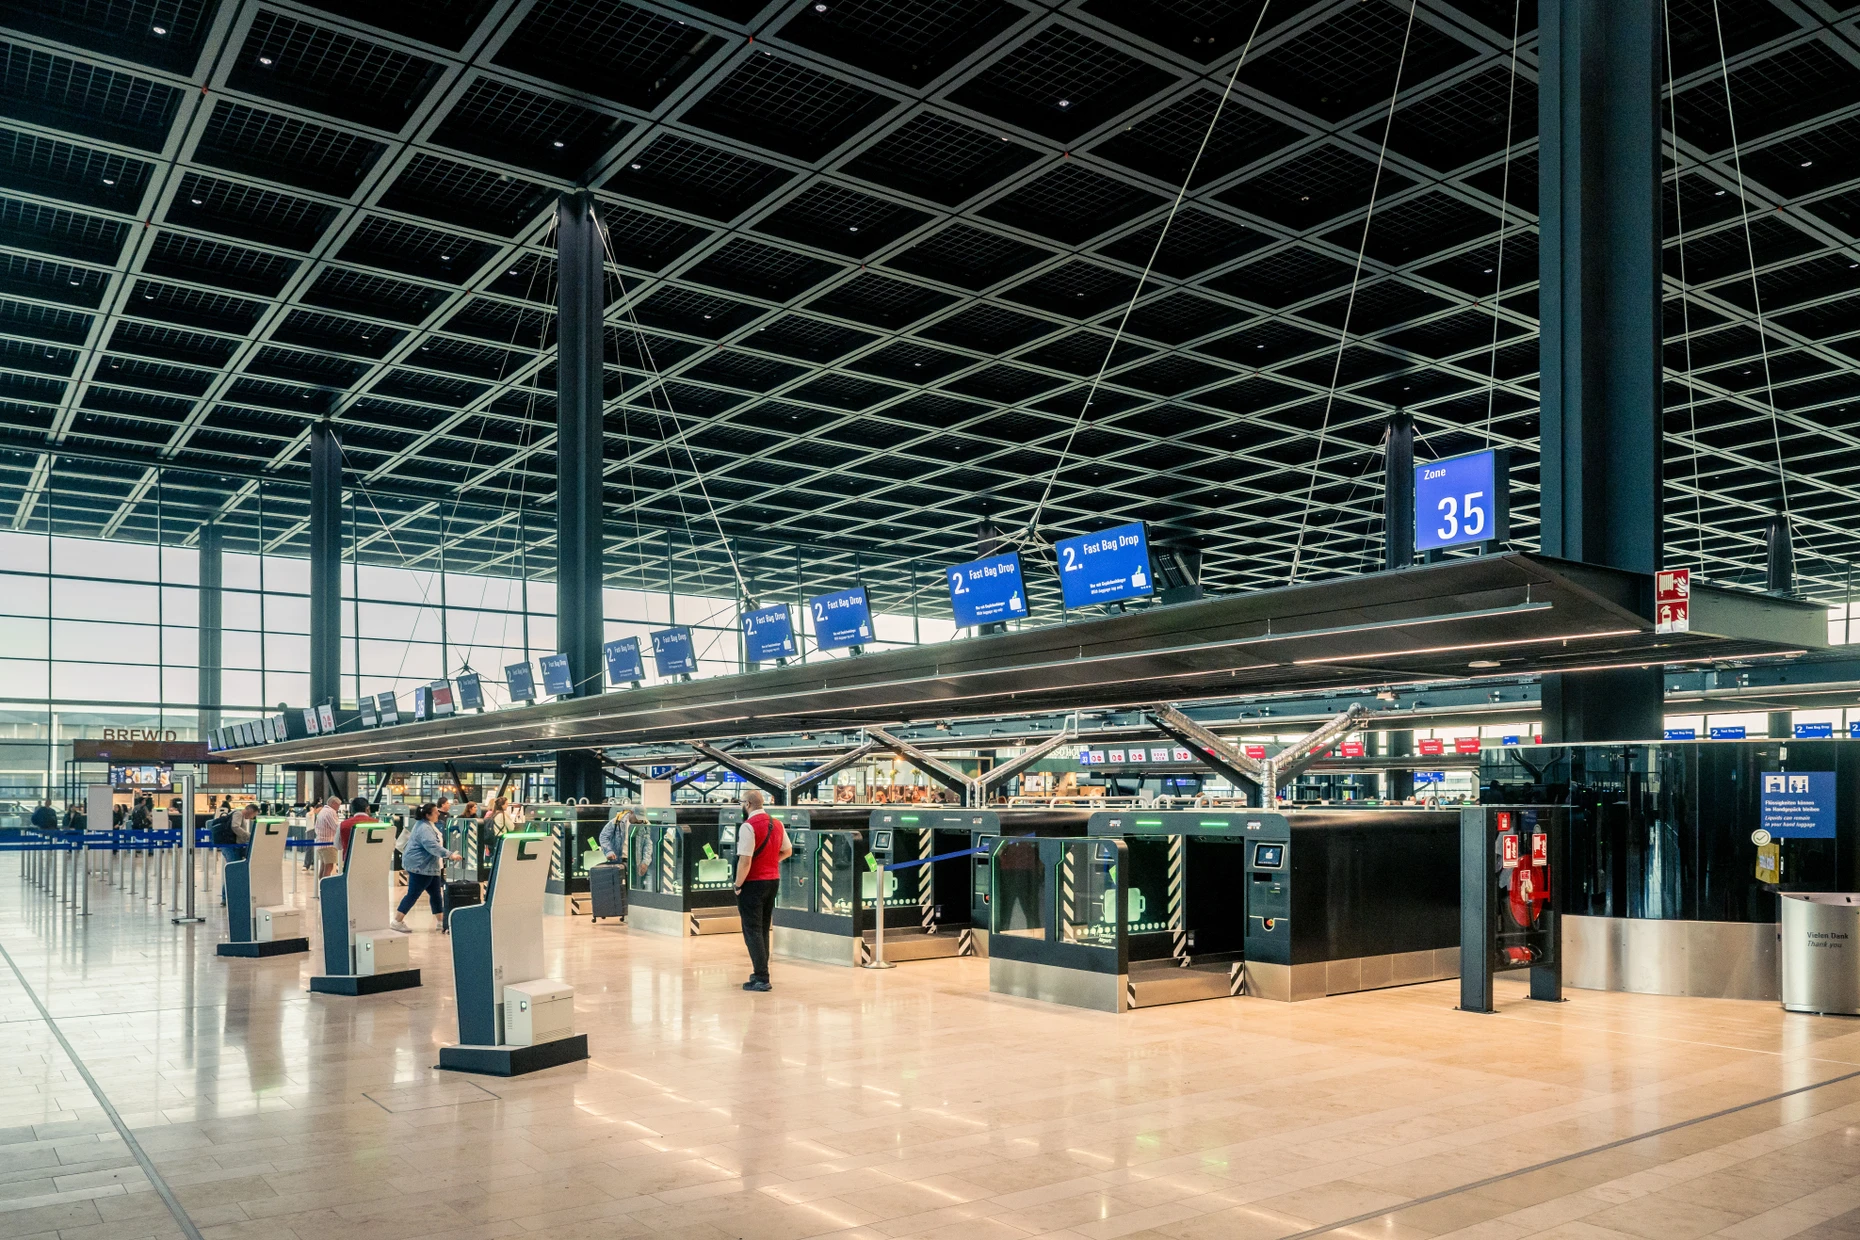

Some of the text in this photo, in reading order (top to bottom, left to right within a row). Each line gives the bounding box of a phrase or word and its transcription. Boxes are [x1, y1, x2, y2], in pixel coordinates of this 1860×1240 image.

[1424, 468, 1446, 480] Zone
[1438, 491, 1484, 540] 35
[1083, 535, 1139, 555] Fast Bag Drop
[1063, 547, 1083, 572] 2.
[969, 564, 1014, 580] Fast Bag Drop
[952, 572, 970, 594] 2.
[827, 596, 862, 609] Fast Bag Drop
[766, 614, 774, 623] Bag
[775, 613, 786, 621] Drop
[815, 602, 828, 622] 2.
[746, 618, 757, 636] 2.
[654, 637, 664, 652] 2.
[607, 648, 616, 662] 2.
